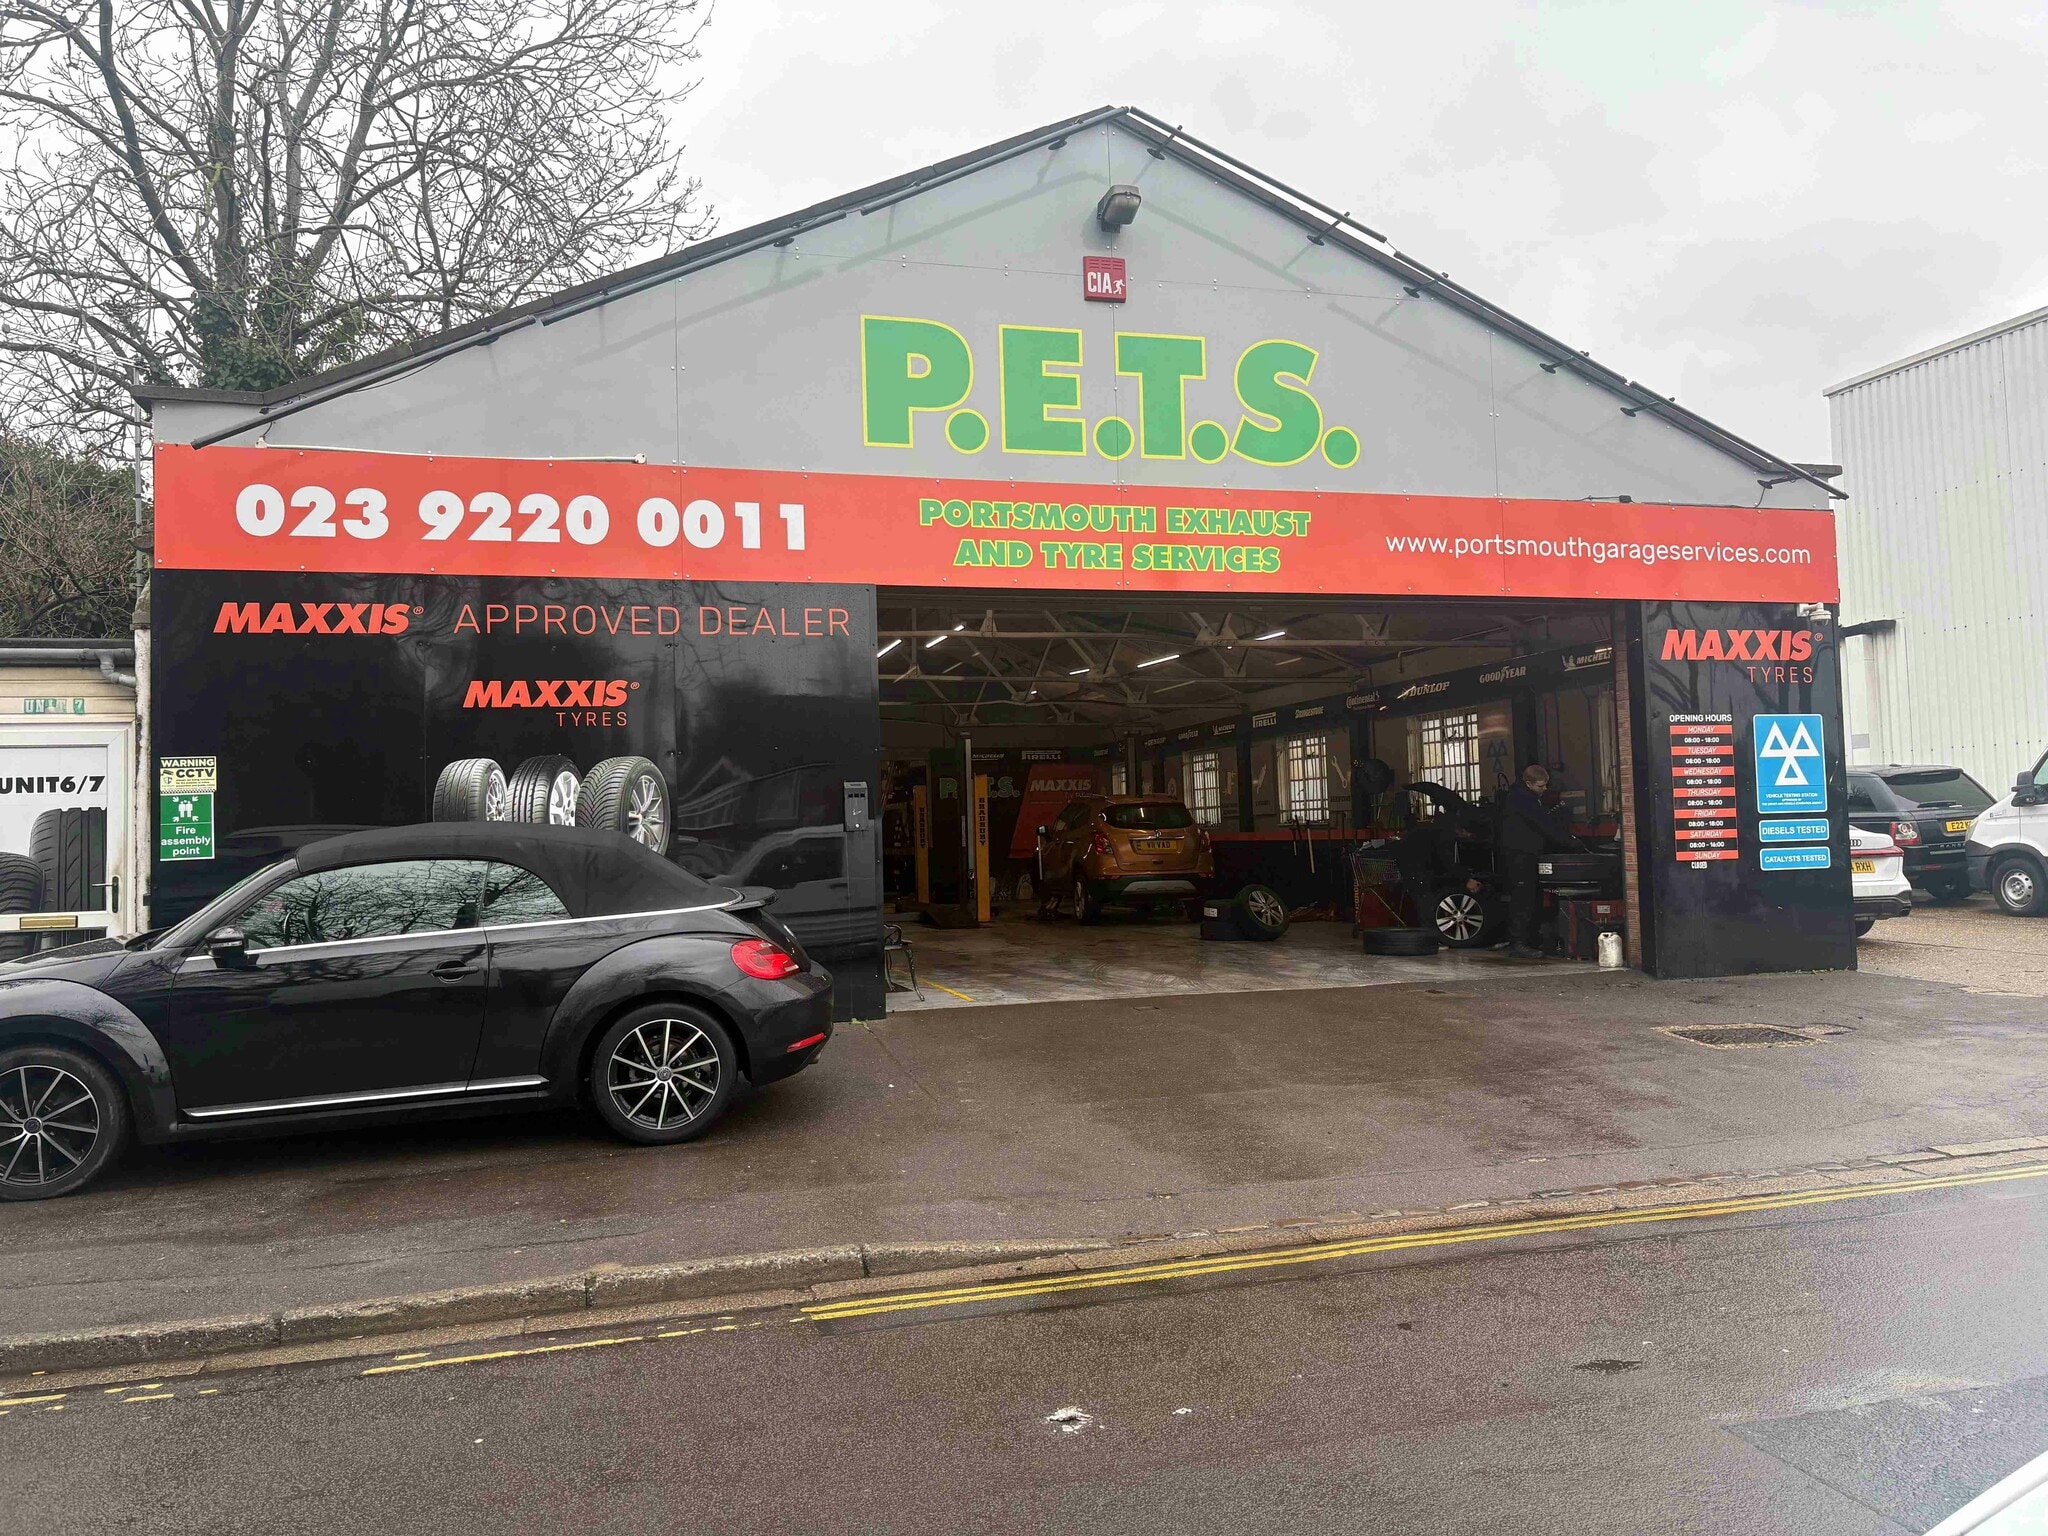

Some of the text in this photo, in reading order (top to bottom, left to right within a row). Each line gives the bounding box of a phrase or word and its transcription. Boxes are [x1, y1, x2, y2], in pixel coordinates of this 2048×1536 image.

[1087, 271, 1112, 294] CIA
[860, 314, 1360, 469] P.E.T.S.
[235, 484, 806, 550] 023 9220 0011
[919, 498, 1311, 538] PORTSMOUTH EXHAUST
[1385, 534, 1811, 566] www.portsmouthgarageservices.com
[954, 538, 1281, 574] AND TYRE SERVICES
[453, 604, 680, 636] APPROVED
[699, 607, 851, 637] DEALER
[1479, 665, 1526, 683] GOODYEAR
[1747, 666, 1813, 683] TYRES
[1409, 681, 1450, 697] DUNLOP
[556, 711, 628, 727] TYRES
[1252, 711, 1277, 728] PIRELLI
[1669, 714, 1732, 722] OPENING HOURS
[1688, 726, 1715, 734] MONDAY
[1021, 750, 1061, 760] PIRELLI
[161, 759, 214, 767] WARNING
[176, 768, 215, 778] CCTV
[1684, 767, 1723, 775] WEDNESDAY
[0, 775, 106, 795] UNIT6/7
[1030, 779, 1092, 792] MAXXIS
[1687, 788, 1721, 796] THURSDAY
[175, 826, 196, 834] Fire
[1762, 825, 1826, 835] DIESELS TESTED
[1951, 821, 1964, 830] E22
[1689, 830, 1723, 839] SATURDAY
[161, 836, 211, 846] assembly
[173, 847, 200, 857] point
[1765, 854, 1827, 863] CATALYSTS TESTED
[1855, 861, 1872, 871] RXH
